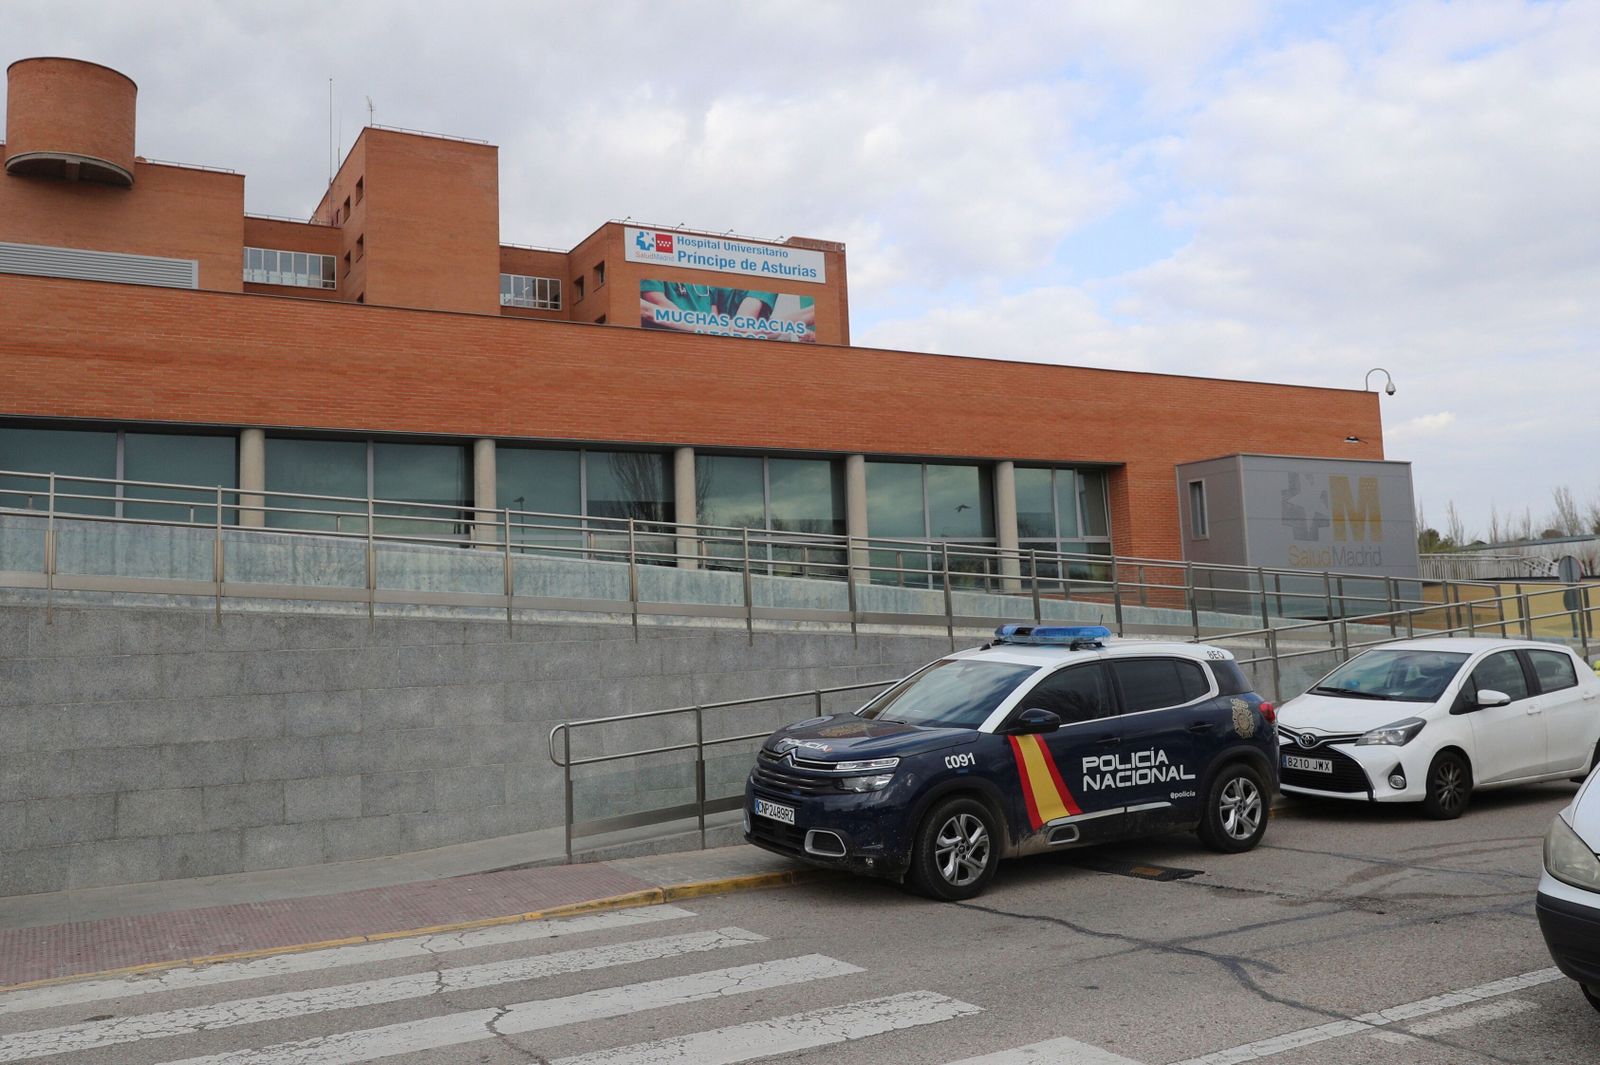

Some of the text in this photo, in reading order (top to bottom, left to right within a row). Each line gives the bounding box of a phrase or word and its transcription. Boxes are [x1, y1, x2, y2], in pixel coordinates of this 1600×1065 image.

[677, 236, 789, 258] Hospital Universitario
[678, 250, 817, 278] Príncipe de Asturias
[655, 309, 805, 334] MUCHAS GRACIAS
[1288, 544, 1382, 568] SaludMadrid
[1082, 747, 1169, 774] POLICÍA
[1287, 757, 1330, 771] 8210 JWX
[1083, 764, 1196, 792] NACIONAL
